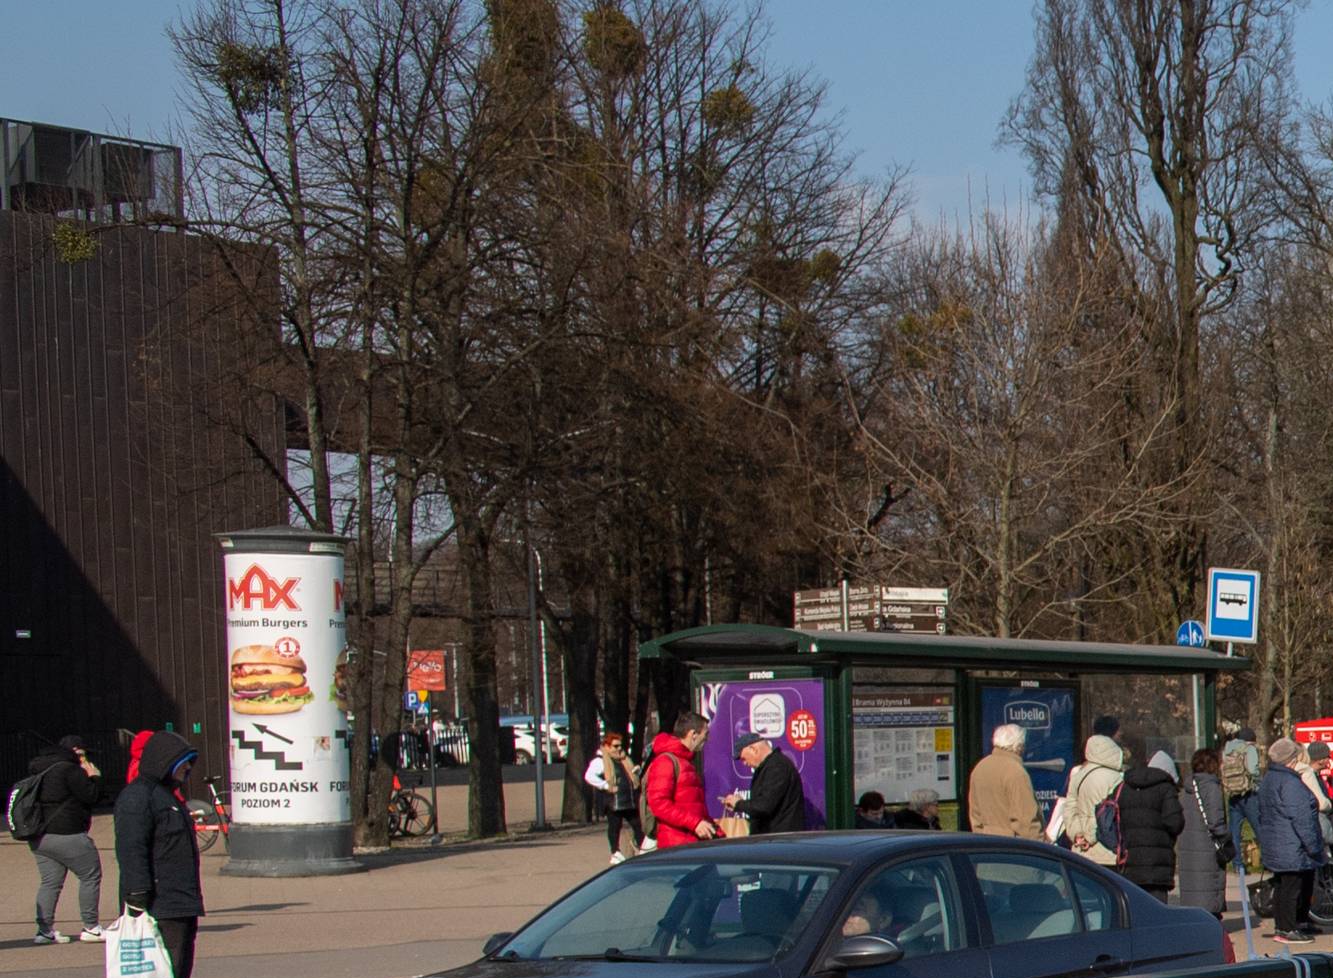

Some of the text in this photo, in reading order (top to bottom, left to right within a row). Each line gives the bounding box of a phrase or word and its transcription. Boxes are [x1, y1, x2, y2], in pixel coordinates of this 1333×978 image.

[229, 564, 301, 611] MAX
[262, 618, 308, 629] Burgers
[408, 693, 417, 707] P
[1009, 708, 1045, 721] Lubella
[791, 720, 808, 739] 50
[260, 779, 319, 793] GDAŃSK
[241, 798, 291, 808] POZIOM 2
